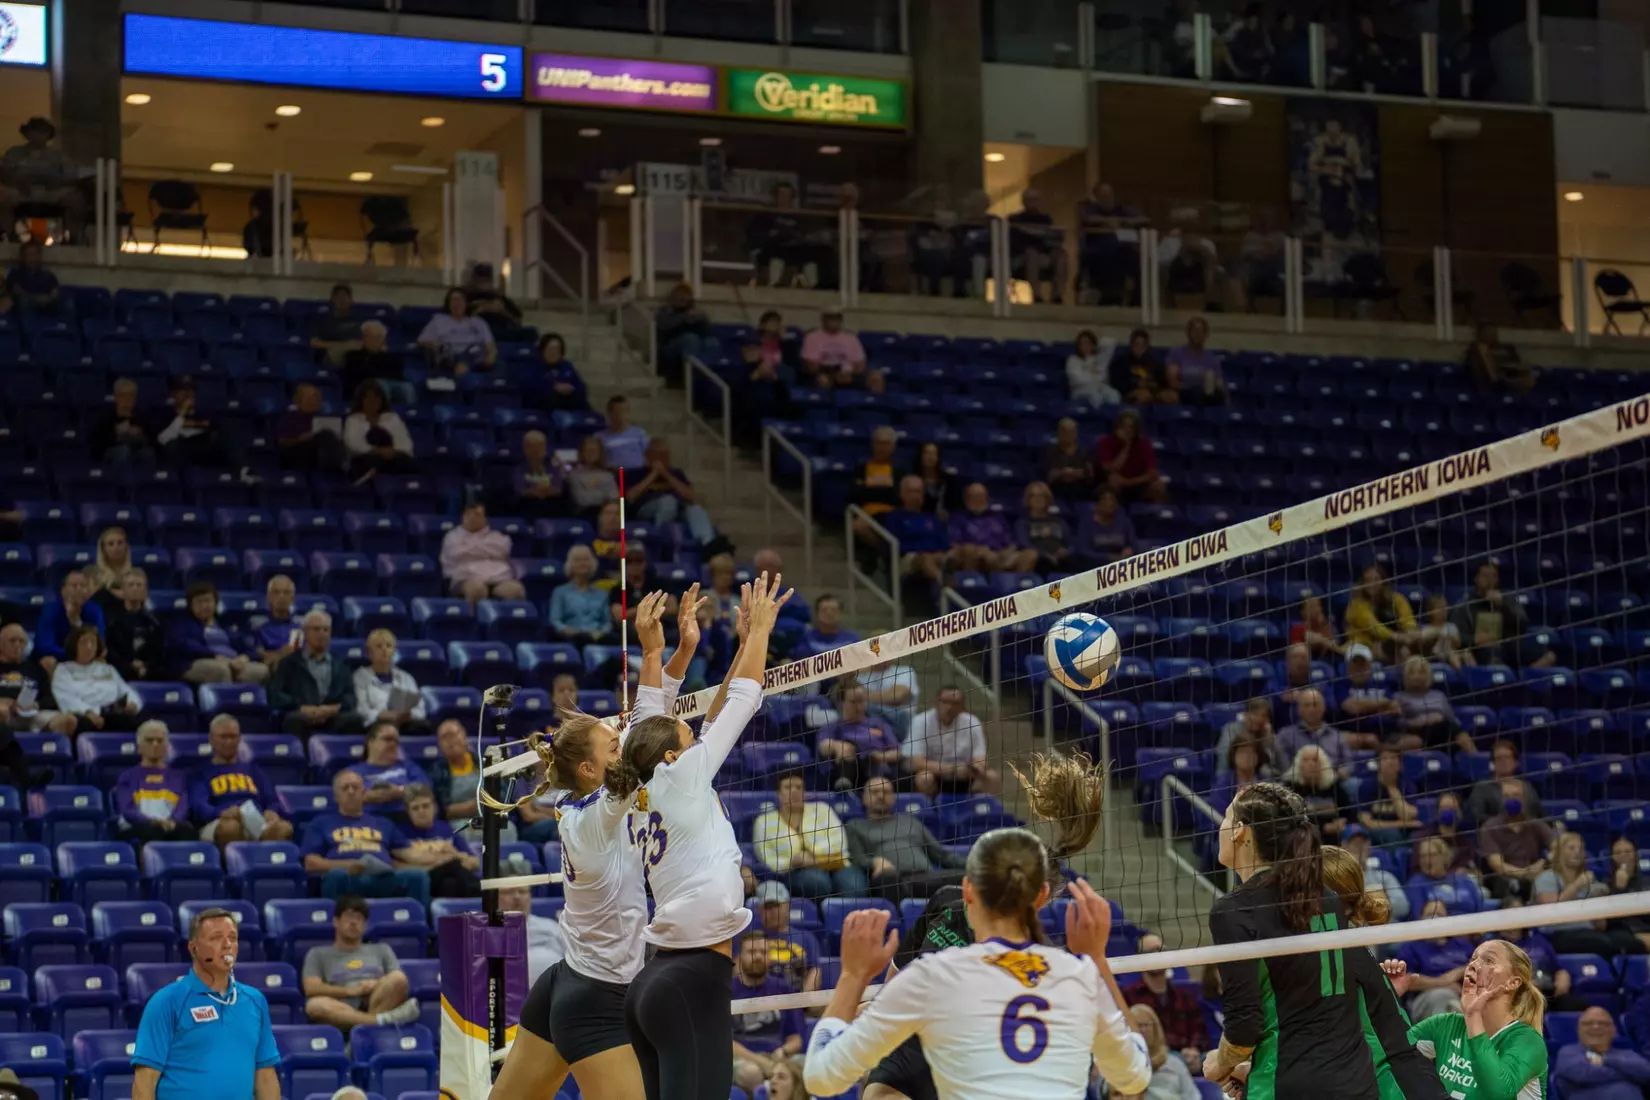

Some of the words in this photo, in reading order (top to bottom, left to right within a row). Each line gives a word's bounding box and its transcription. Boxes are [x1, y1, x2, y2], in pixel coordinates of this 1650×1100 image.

[480, 54, 507, 92] 5
[537, 66, 711, 98] UNIPanthers.com
[754, 72, 878, 114] Veridian
[649, 171, 688, 191] 115
[1324, 467, 1429, 519] NORTHERN
[1437, 449, 1491, 487] IOWA
[1097, 550, 1179, 591] NORTHERN
[1185, 530, 1228, 563] IOWA
[909, 607, 977, 647] NORTHERN
[982, 596, 1018, 626] IOWA
[813, 649, 843, 676] IOWA
[210, 773, 257, 795] UNI
[1001, 993, 1051, 1064] 6
[1439, 1064, 1478, 1088] DAKO
